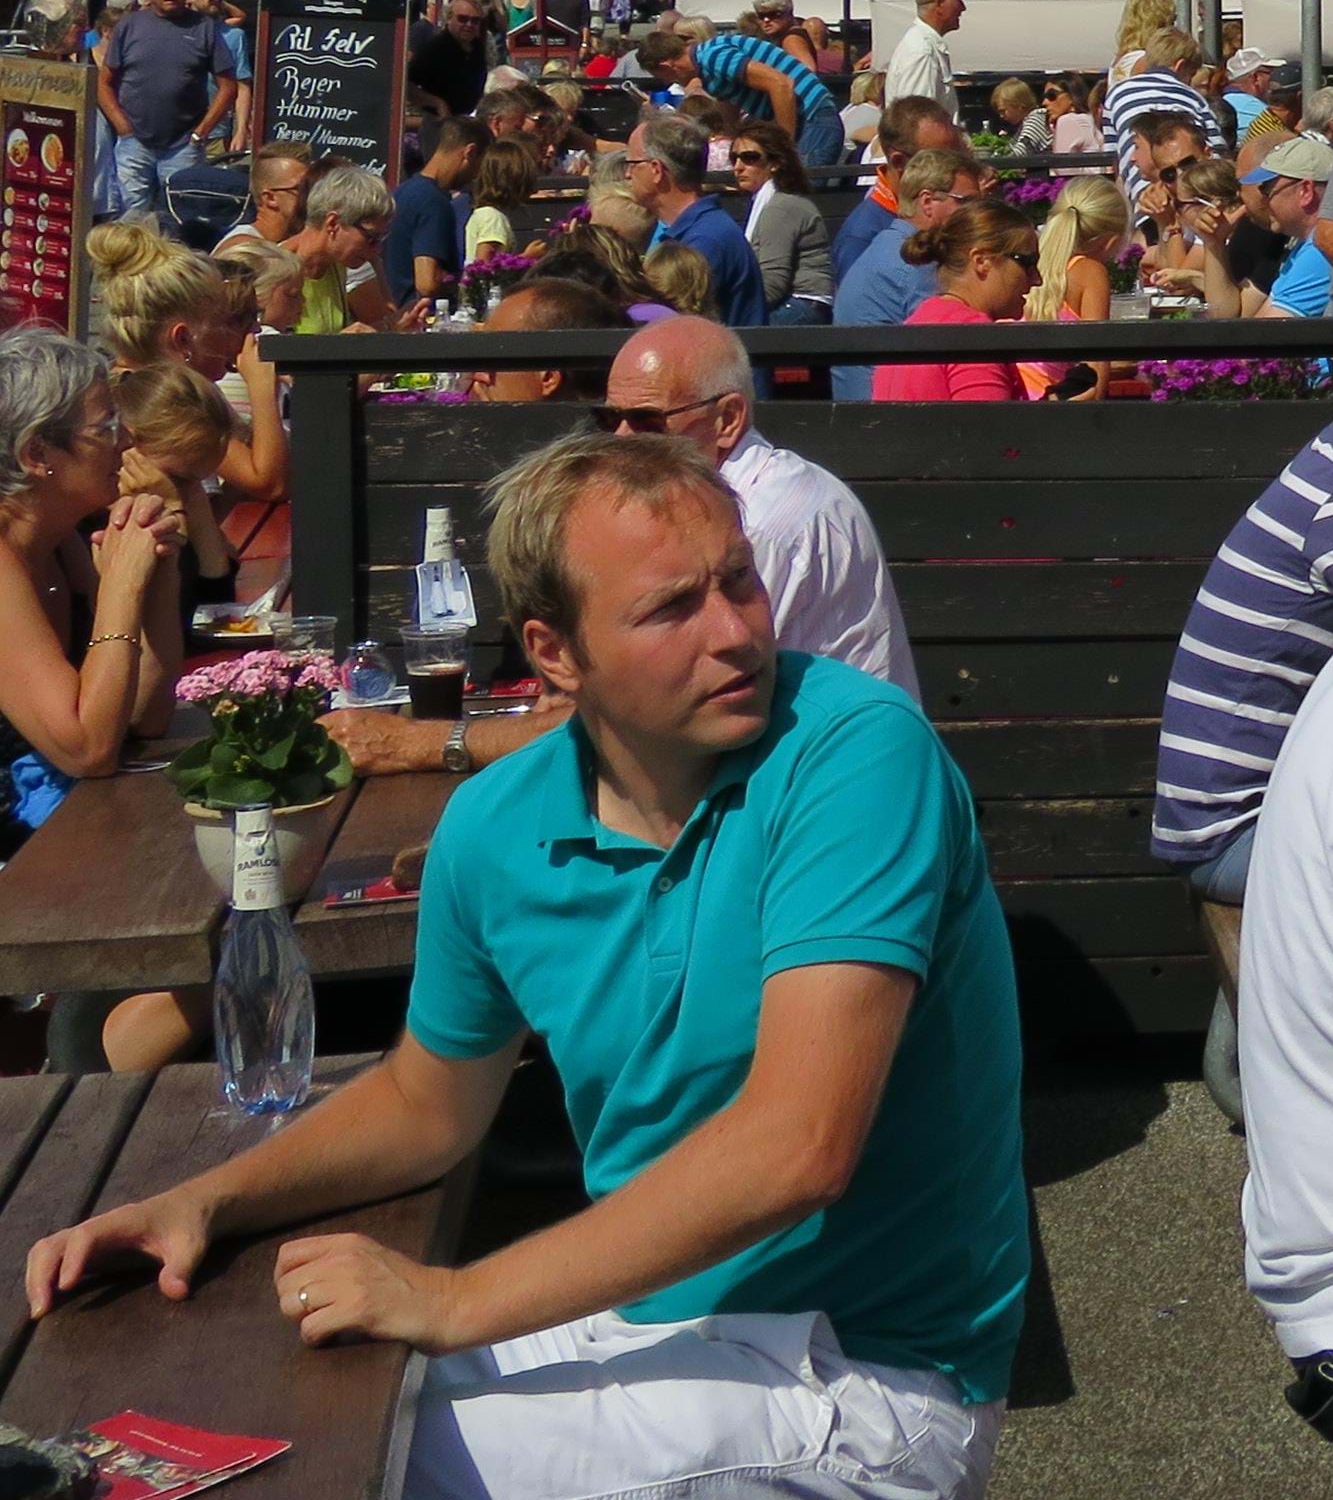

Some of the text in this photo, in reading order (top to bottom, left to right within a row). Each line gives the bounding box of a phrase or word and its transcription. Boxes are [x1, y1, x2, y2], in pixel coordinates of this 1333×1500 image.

[274, 23, 313, 50] Pil
[275, 66, 341, 99] Rejer
[276, 98, 358, 121] Hummer
